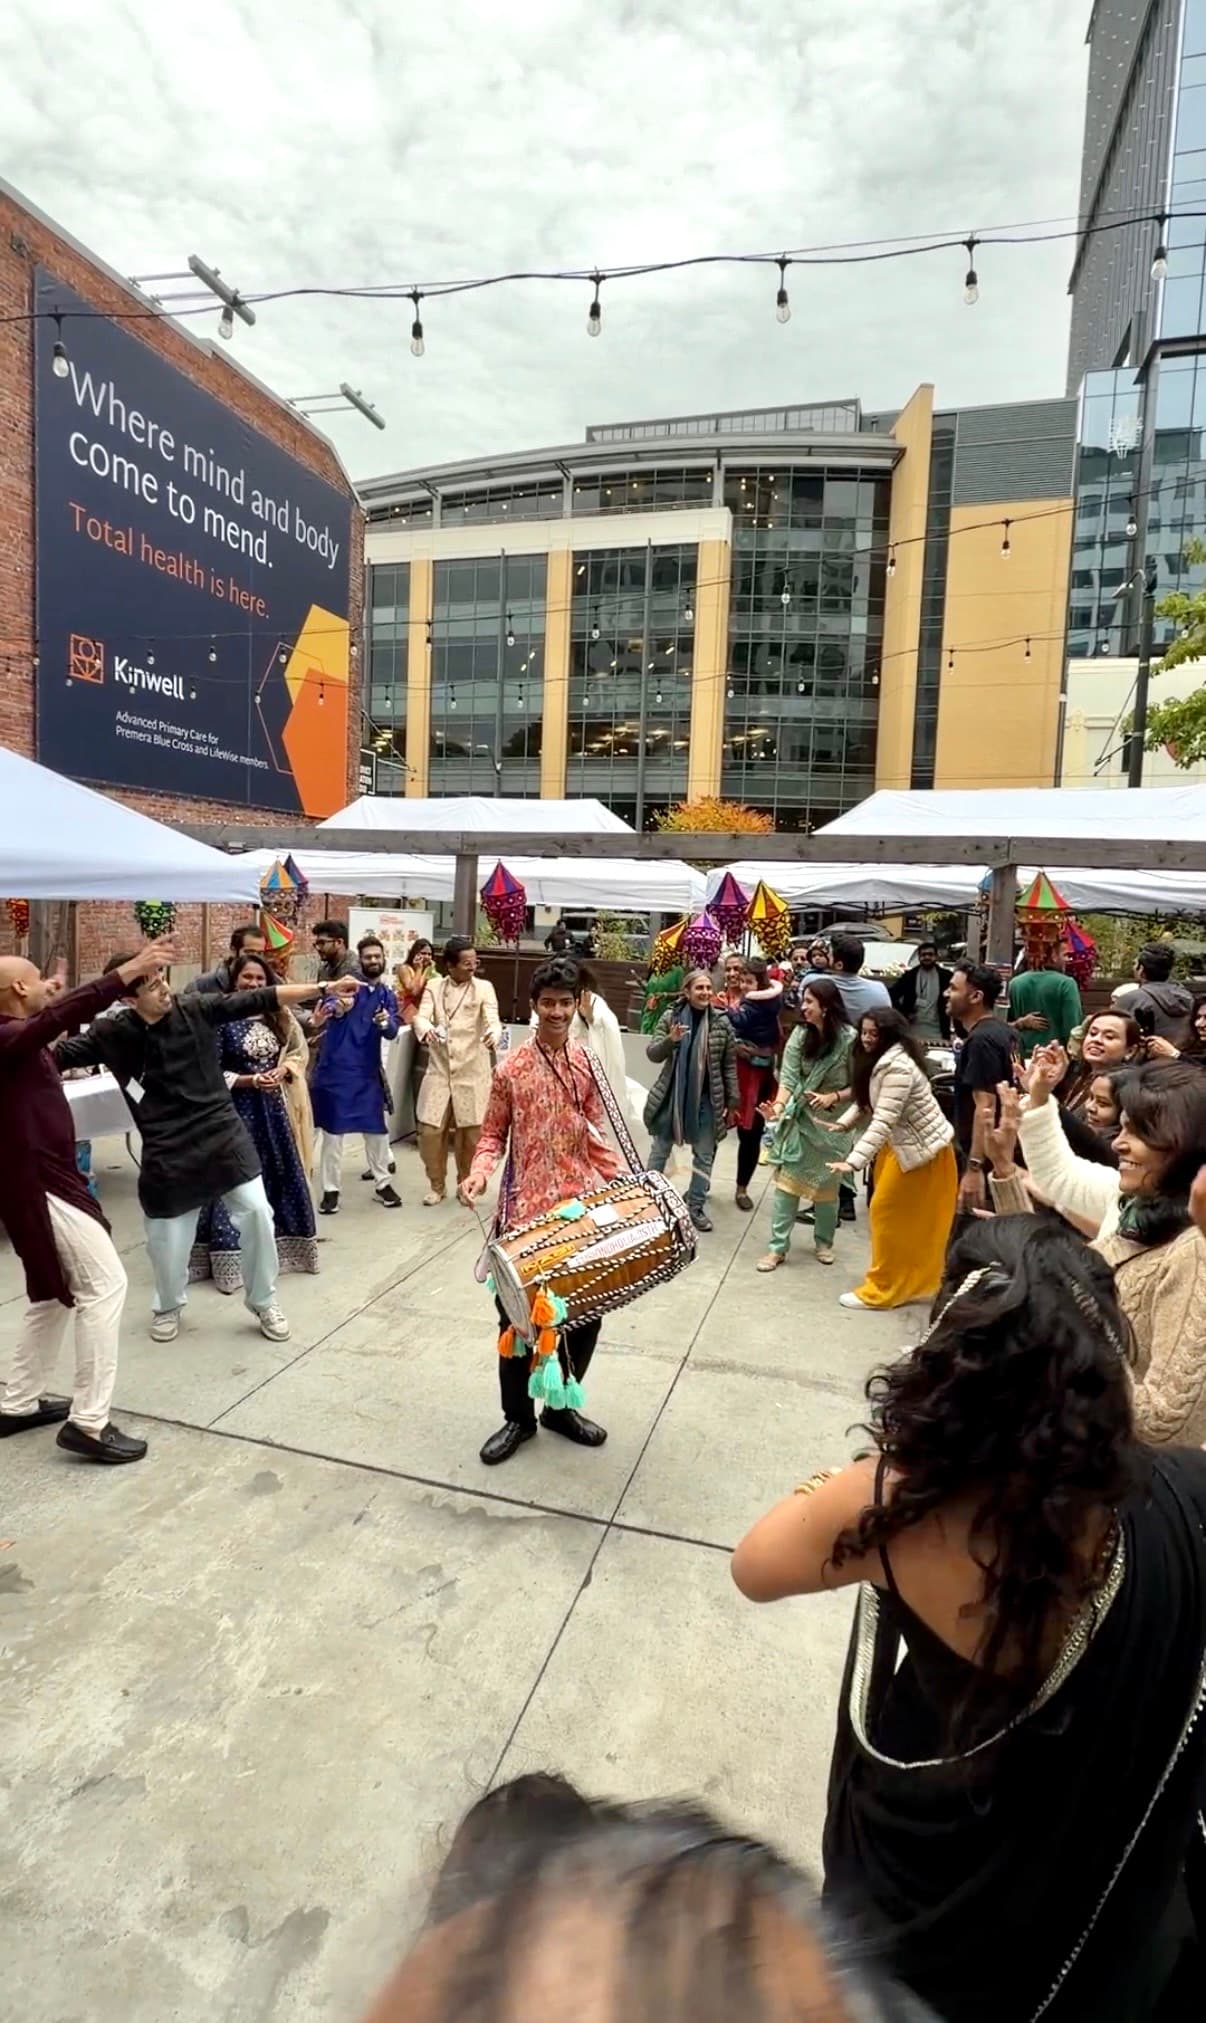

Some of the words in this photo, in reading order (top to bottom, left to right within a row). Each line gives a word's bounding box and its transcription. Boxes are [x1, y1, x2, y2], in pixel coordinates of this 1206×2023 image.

[69, 361, 175, 461] Where
[184, 444, 245, 506] mind
[251, 489, 289, 534] and
[295, 506, 339, 570] body
[69, 432, 158, 503] come
[166, 480, 196, 524] to
[204, 506, 273, 569] mend.
[69, 502, 133, 557] Total
[140, 533, 204, 590] health
[210, 567, 225, 599] is
[229, 577, 270, 620] here.
[114, 655, 185, 701] Kinwell
[115, 710, 158, 731] Advanced
[159, 720, 189, 741] Primary
[189, 728, 208, 743] Care
[208, 732, 219, 745] for
[115, 725, 153, 744] Premera
[153, 734, 171, 748] Blue
[171, 738, 194, 753] Cross
[194, 745, 209, 756] and
[209, 747, 239, 763] LifeWise
